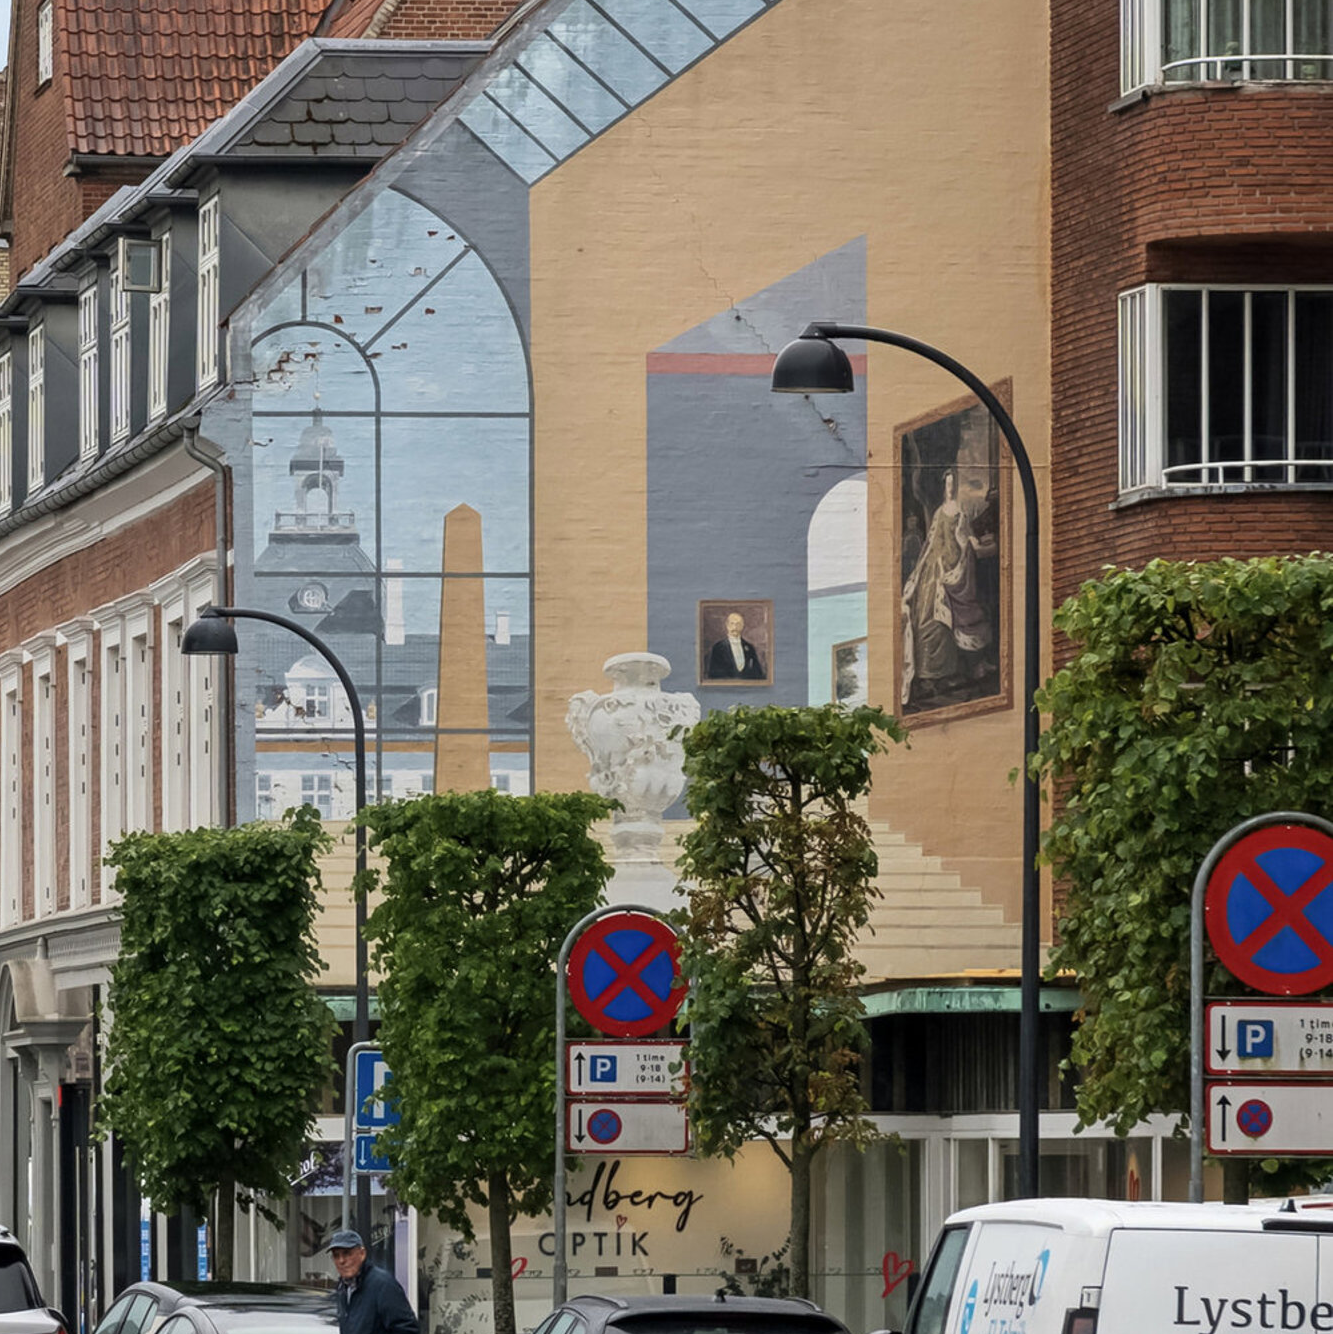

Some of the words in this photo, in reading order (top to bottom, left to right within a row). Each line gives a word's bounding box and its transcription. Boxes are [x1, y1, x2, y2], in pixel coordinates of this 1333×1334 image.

[1300, 1018, 1305, 1028] 1
[1309, 1018, 1333, 1029] tim
[1246, 1024, 1266, 1054] P
[643, 1054, 665, 1062] time
[596, 1058, 611, 1079] P
